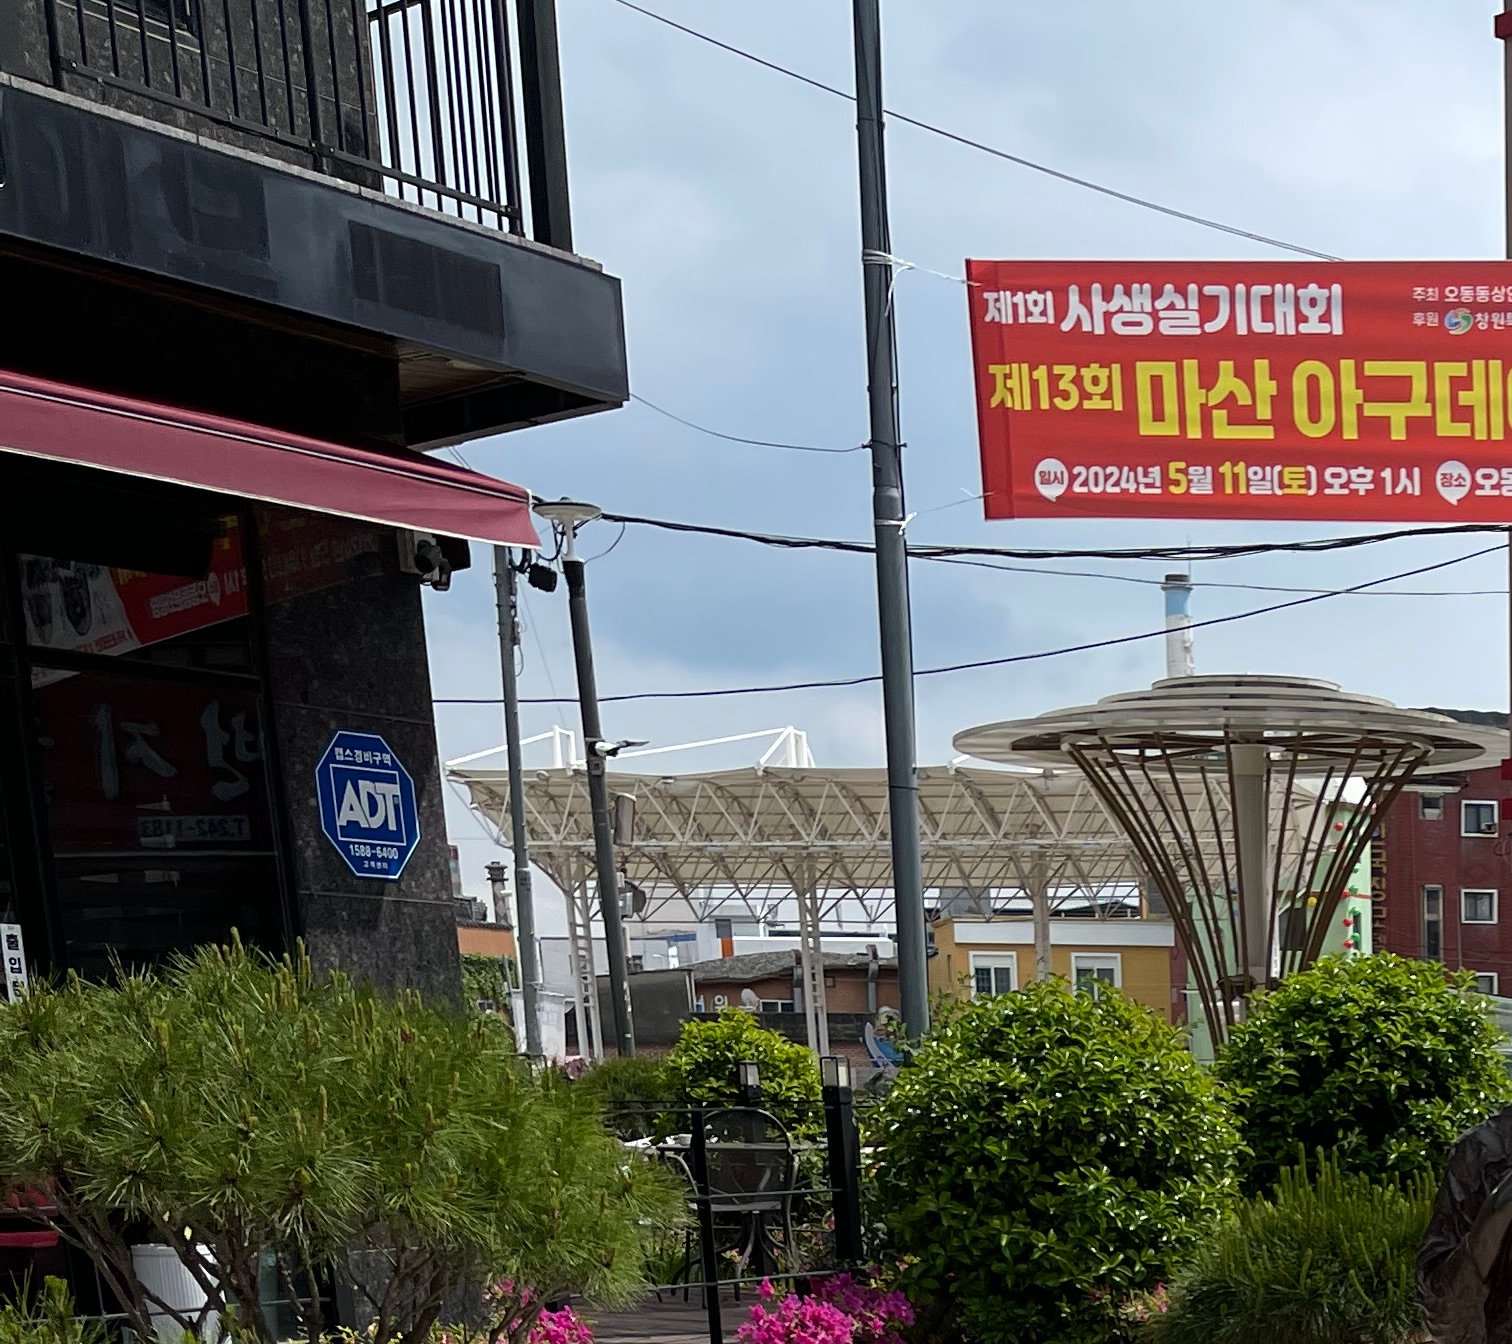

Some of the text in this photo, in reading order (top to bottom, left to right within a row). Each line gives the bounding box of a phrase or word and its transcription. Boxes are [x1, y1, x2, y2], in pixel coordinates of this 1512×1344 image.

[1413, 287, 1439, 302] 주최
[983, 283, 1344, 336] 제1회 사생실기대회
[1413, 312, 1439, 327] 후원
[988, 362, 1124, 412] 제13회
[1136, 358, 1278, 440] 마산
[1039, 461, 1421, 496] 일시 2024년 5월 11일(토) 오후 1시
[1440, 472, 1467, 488] 장소
[334, 747, 393, 766] 캡스경비구역
[338, 779, 401, 831] ADT
[350, 844, 399, 860] 1588-6400
